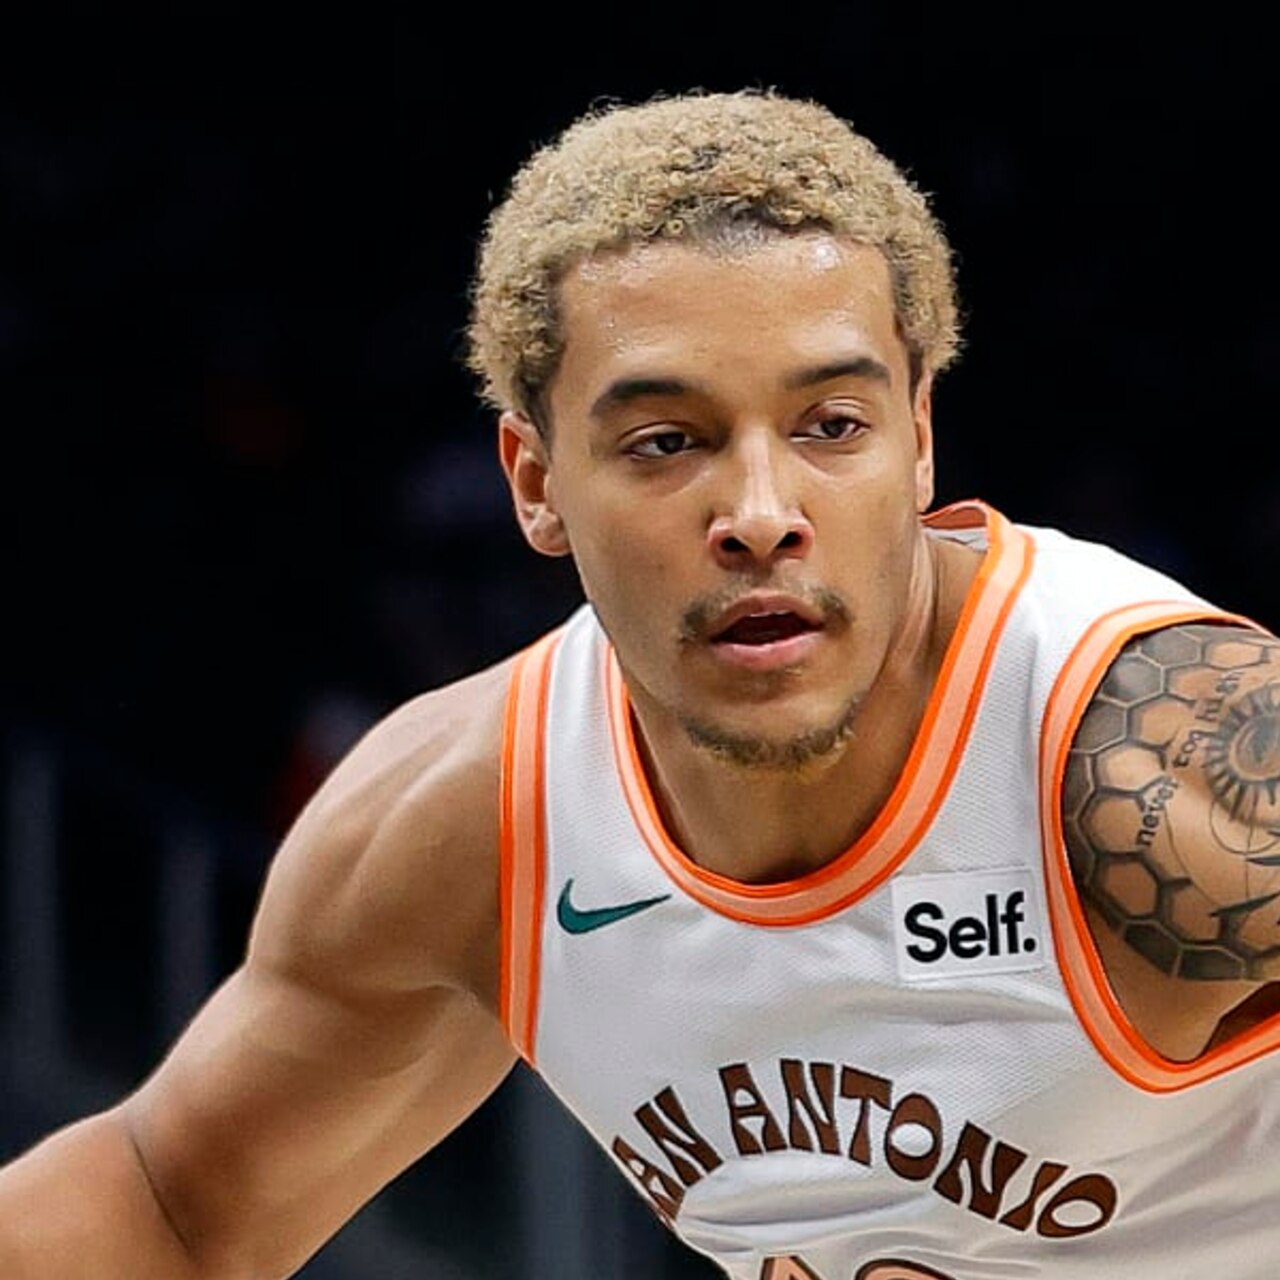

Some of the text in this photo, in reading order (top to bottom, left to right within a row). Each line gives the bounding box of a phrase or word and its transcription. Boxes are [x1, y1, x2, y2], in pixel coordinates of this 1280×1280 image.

[903, 890, 1037, 963] Self.
[612, 1058, 1118, 1239] AN ANTONIO
